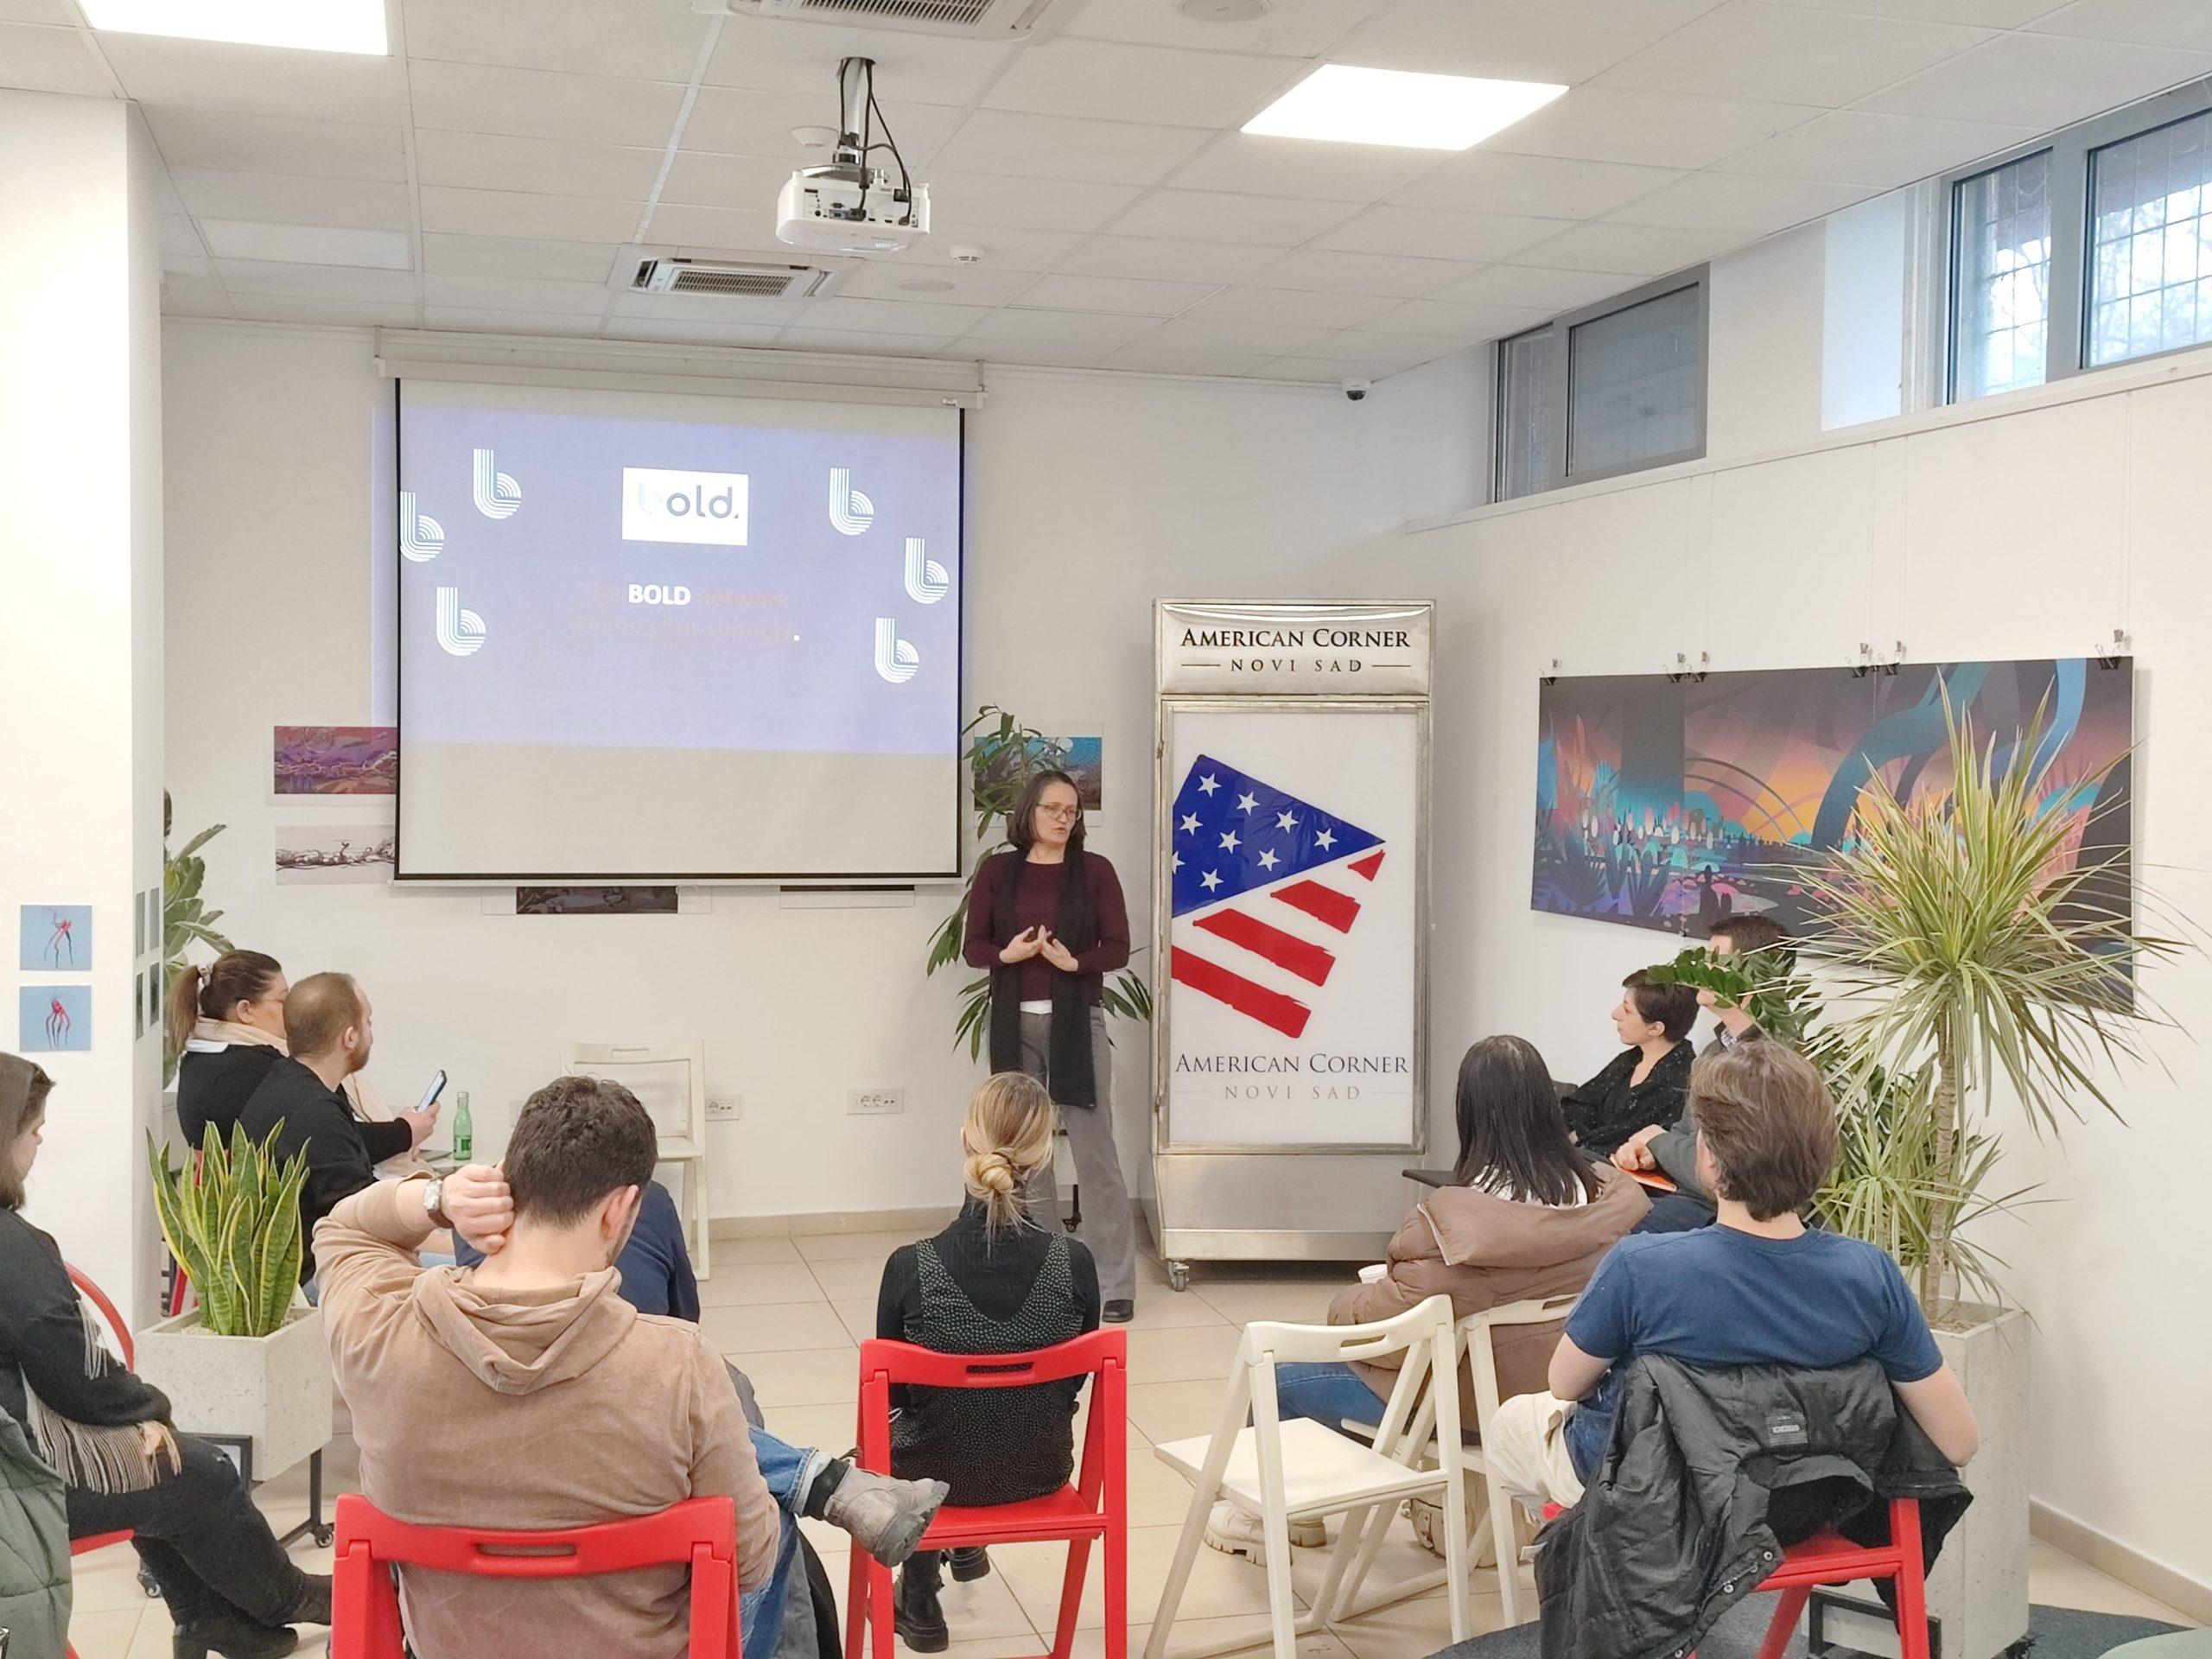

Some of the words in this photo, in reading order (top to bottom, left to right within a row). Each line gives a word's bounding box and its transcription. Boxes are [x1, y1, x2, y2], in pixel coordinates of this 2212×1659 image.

[628, 583, 691, 606] BOLD
[1181, 627, 1304, 648] AMERICAN
[1313, 627, 1411, 648] CORNER
[1230, 659, 1295, 672] NOVI
[1315, 659, 1362, 673] SAD
[1175, 1053, 1300, 1073] AMERICAN
[1309, 1052, 1409, 1074] CORNER
[1224, 1085, 1291, 1100] NOVI
[1312, 1085, 1361, 1101] SAD
